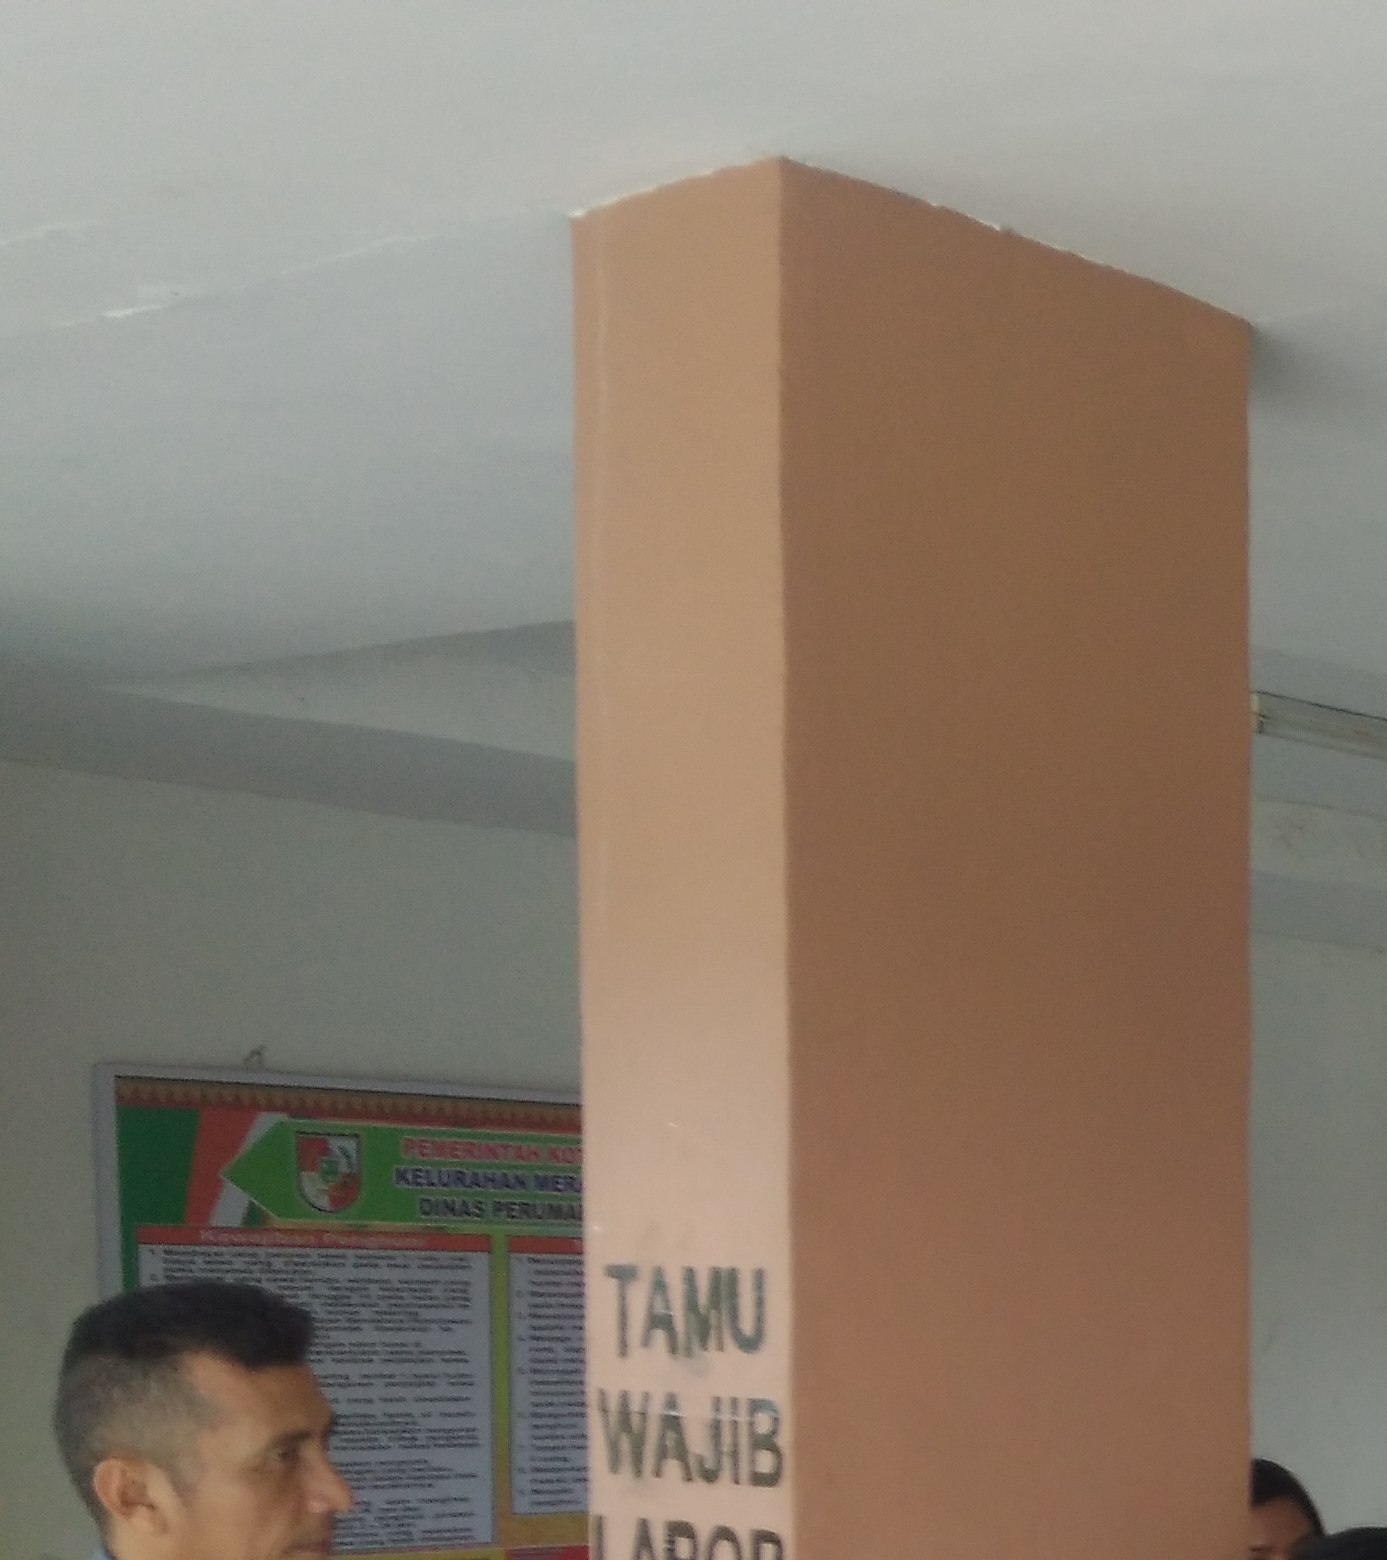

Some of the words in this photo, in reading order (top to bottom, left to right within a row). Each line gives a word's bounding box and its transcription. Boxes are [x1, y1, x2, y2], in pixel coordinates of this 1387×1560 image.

[394, 1167, 528, 1190] KELURAHAN
[419, 1197, 486, 1219] DINAS
[603, 1264, 765, 1357] TAMU
[596, 1387, 783, 1487] WAJIB
